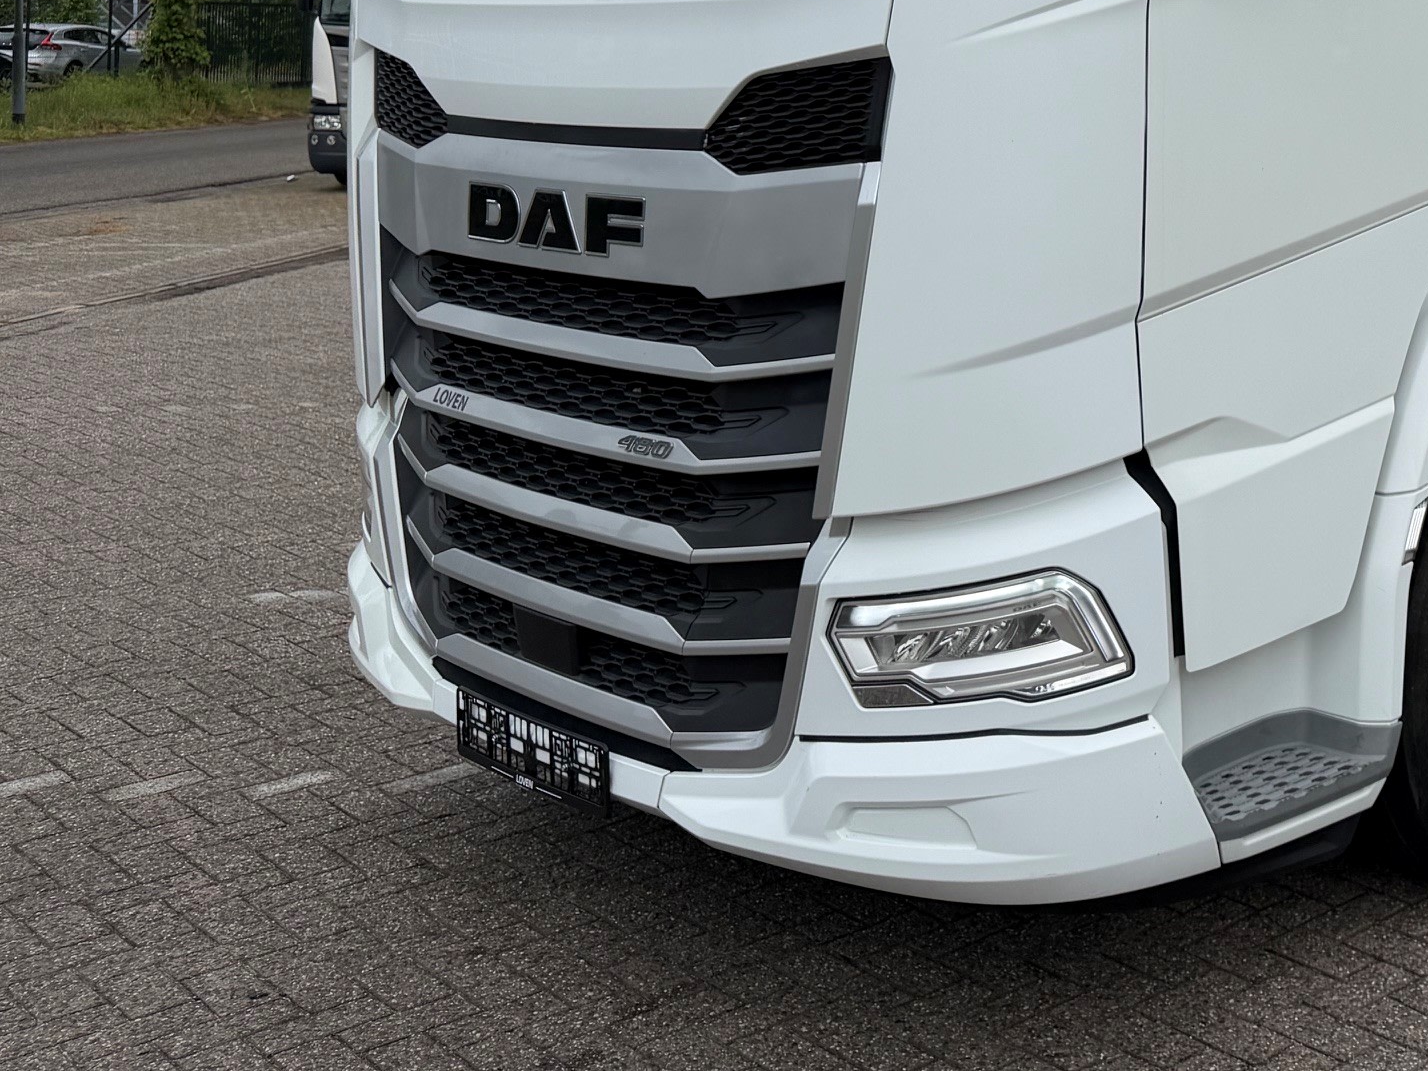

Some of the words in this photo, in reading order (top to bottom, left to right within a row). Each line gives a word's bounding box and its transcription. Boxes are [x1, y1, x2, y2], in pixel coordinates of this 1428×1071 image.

[467, 181, 647, 257] DAF
[432, 386, 469, 412] LOVEN
[617, 434, 675, 460] 480
[515, 773, 534, 790] LOVEN
